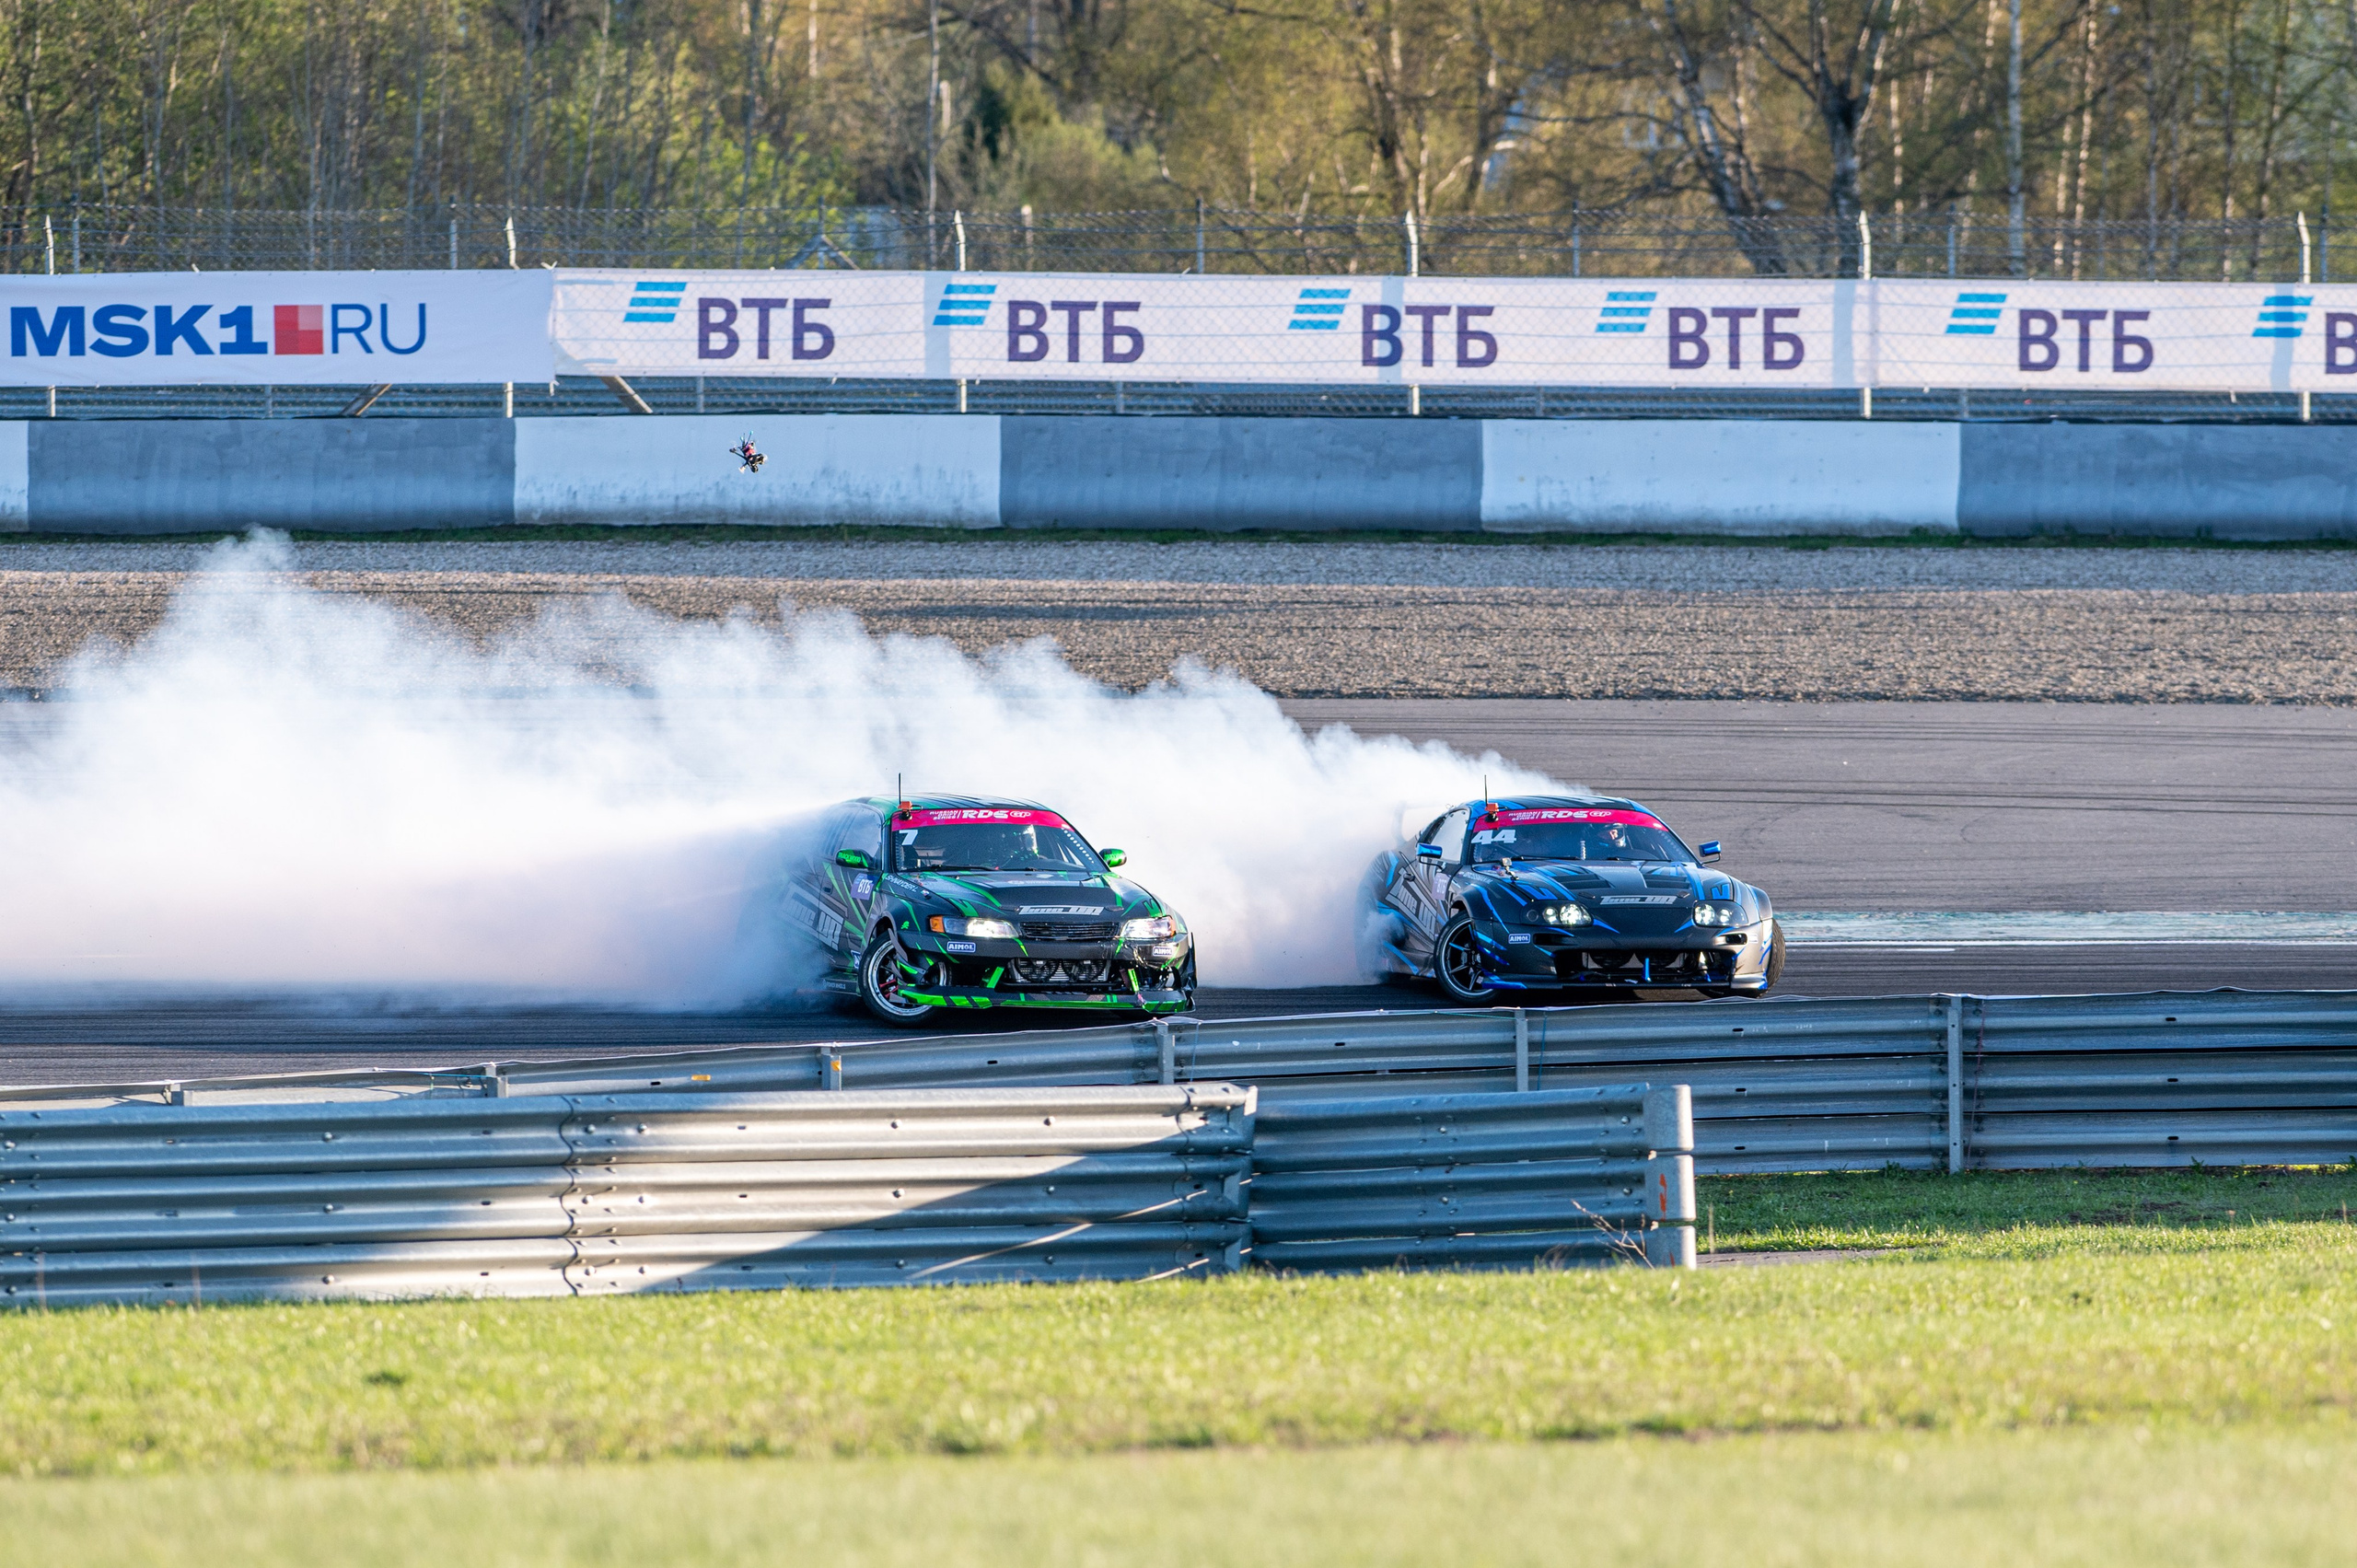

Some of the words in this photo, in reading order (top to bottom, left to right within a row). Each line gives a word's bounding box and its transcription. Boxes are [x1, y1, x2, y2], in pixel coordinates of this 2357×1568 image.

[697, 297, 835, 360] ВТБ
[1007, 300, 1144, 363] ВТБ
[1362, 305, 1498, 367] ВТБ
[1668, 307, 1805, 370] ВТБ
[2019, 308, 2154, 373] ВТБ
[962, 809, 1009, 819] RDS
[1540, 810, 1589, 819] RDS
[899, 830, 918, 846] 7
[1470, 829, 1517, 845] 44
[857, 878, 873, 893] ВТБ
